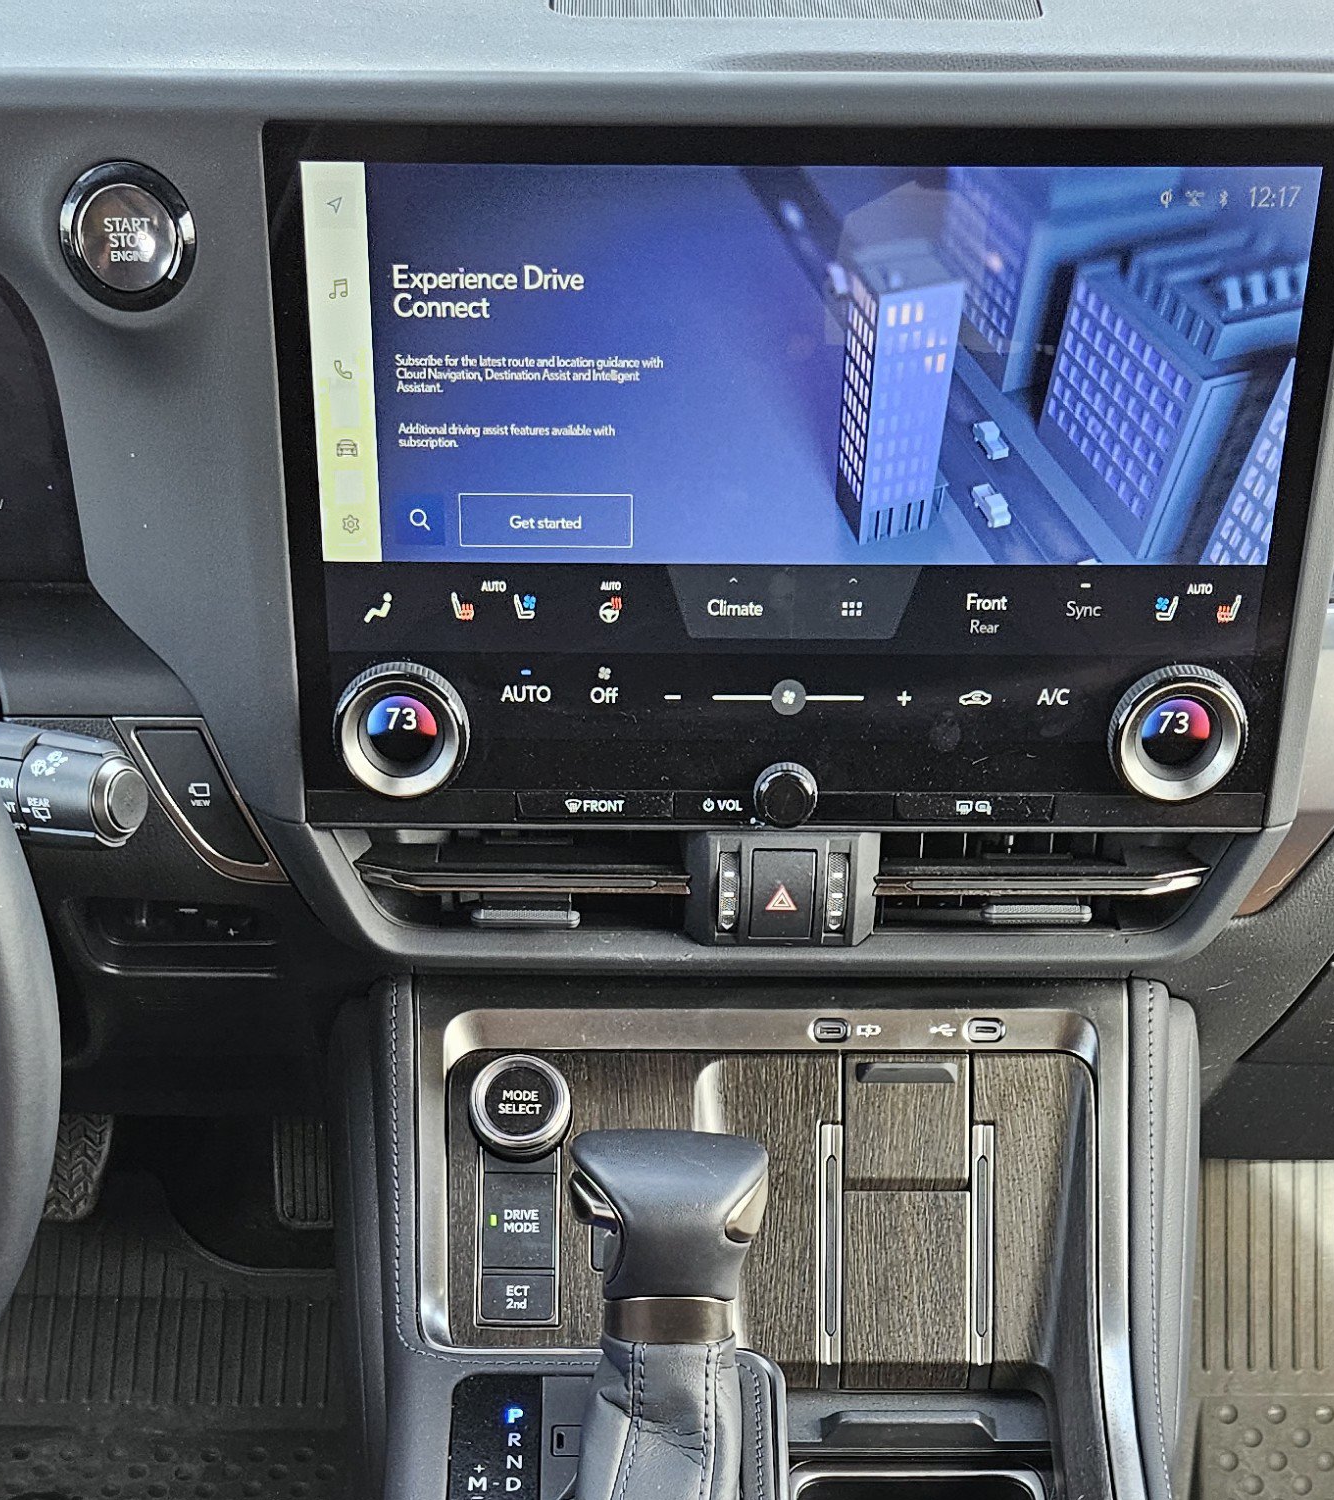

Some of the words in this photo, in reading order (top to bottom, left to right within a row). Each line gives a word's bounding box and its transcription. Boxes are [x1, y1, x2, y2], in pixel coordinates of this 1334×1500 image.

[1250, 186, 1301, 208] 12:17
[103, 218, 151, 232] START
[109, 232, 147, 248] STOP
[111, 251, 150, 262] ENGINE
[392, 264, 518, 294] Experience
[523, 264, 585, 290] Drive
[393, 293, 490, 319] Connect
[395, 354, 443, 367] Subscribe
[445, 355, 458, 367] for
[461, 355, 477, 367] the
[479, 355, 506, 368] latest
[508, 356, 535, 368] route
[536, 356, 556, 368] and
[556, 356, 595, 369] location
[596, 356, 639, 372] guidance
[641, 358, 664, 369] with
[396, 368, 427, 380] Cloud
[428, 368, 483, 383] Navigation,
[485, 369, 541, 381] Destination
[542, 369, 571, 381] Assist
[572, 370, 591, 381] and
[592, 370, 640, 384] Intelligent
[397, 381, 444, 393] Assistant.
[398, 423, 447, 436] Additional
[448, 423, 480, 438] driving
[482, 425, 508, 436] assist
[510, 424, 550, 436] features
[551, 425, 592, 436] available
[593, 425, 616, 436] with
[398, 436, 459, 449] subscription.
[509, 515, 535, 529] Get
[537, 515, 582, 529] started
[481, 581, 507, 592] AUTO
[600, 581, 622, 591] AUTO
[1186, 584, 1213, 595] AUTO
[707, 599, 764, 617] Climate
[966, 593, 1008, 611] Front
[1066, 601, 1102, 620] Sync
[970, 619, 999, 634] Rear
[500, 685, 551, 702] AUTO
[590, 687, 619, 704] Off
[1037, 688, 1070, 705] A/C
[386, 708, 417, 731] 73
[1158, 712, 1189, 734] 73
[27, 797, 50, 808] REAR
[191, 799, 211, 807] VIEW
[583, 800, 625, 813] FRONT
[717, 799, 743, 812] VOL
[503, 1090, 539, 1101] MODE
[498, 1103, 542, 1115] SELECT
[504, 1209, 539, 1220] DRIVE
[504, 1222, 540, 1233] MODE
[506, 1285, 530, 1296] ECT
[506, 1298, 527, 1309] 2nd
[507, 1408, 524, 1424] P
[507, 1432, 522, 1447] R
[506, 1455, 523, 1469] N
[467, 1476, 487, 1492] M
[506, 1477, 522, 1492] D
